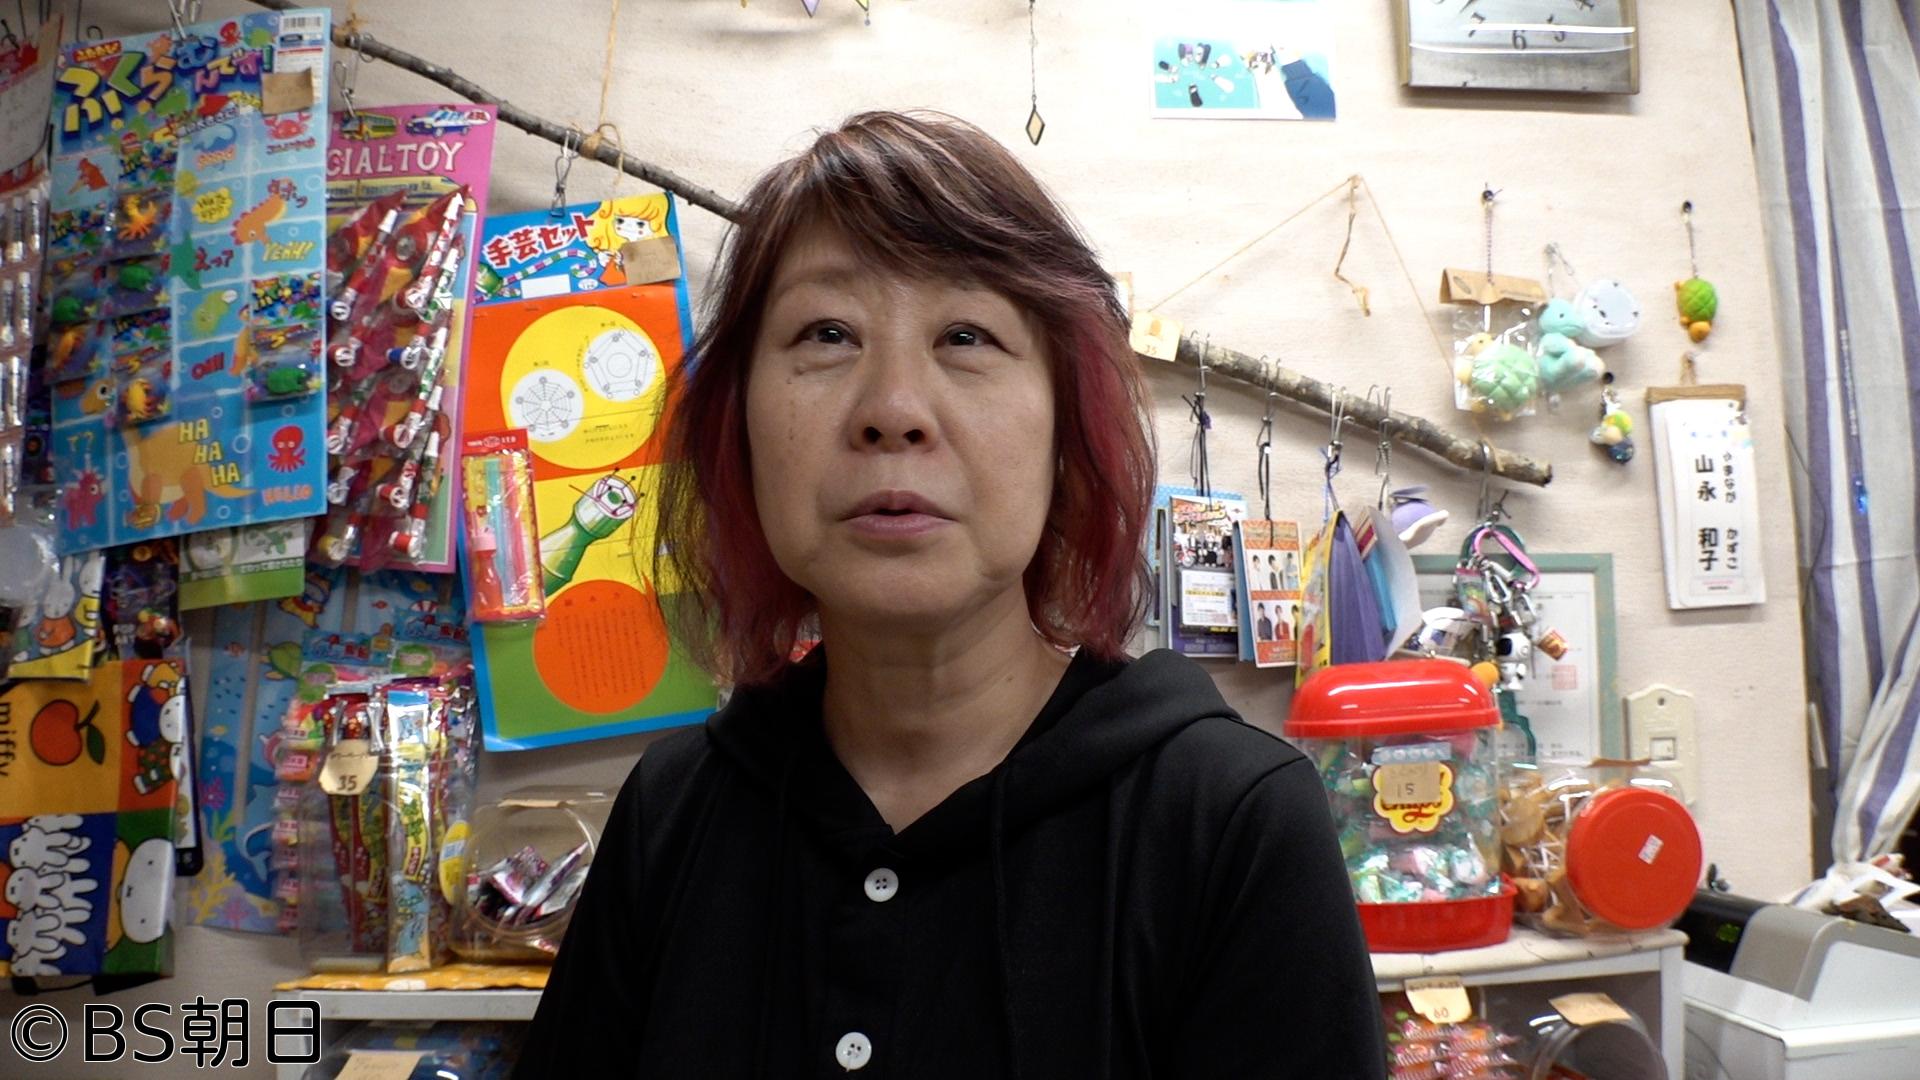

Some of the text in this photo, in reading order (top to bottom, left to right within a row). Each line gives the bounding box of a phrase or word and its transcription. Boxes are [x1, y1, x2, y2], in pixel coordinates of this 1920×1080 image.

[485, 213, 595, 268] 手芸セット
[179, 418, 210, 442] HA
[194, 442, 223, 464] HA
[210, 463, 240, 488] HA
[1695, 454, 1717, 501] 山永
[1698, 527, 1719, 571] 和子
